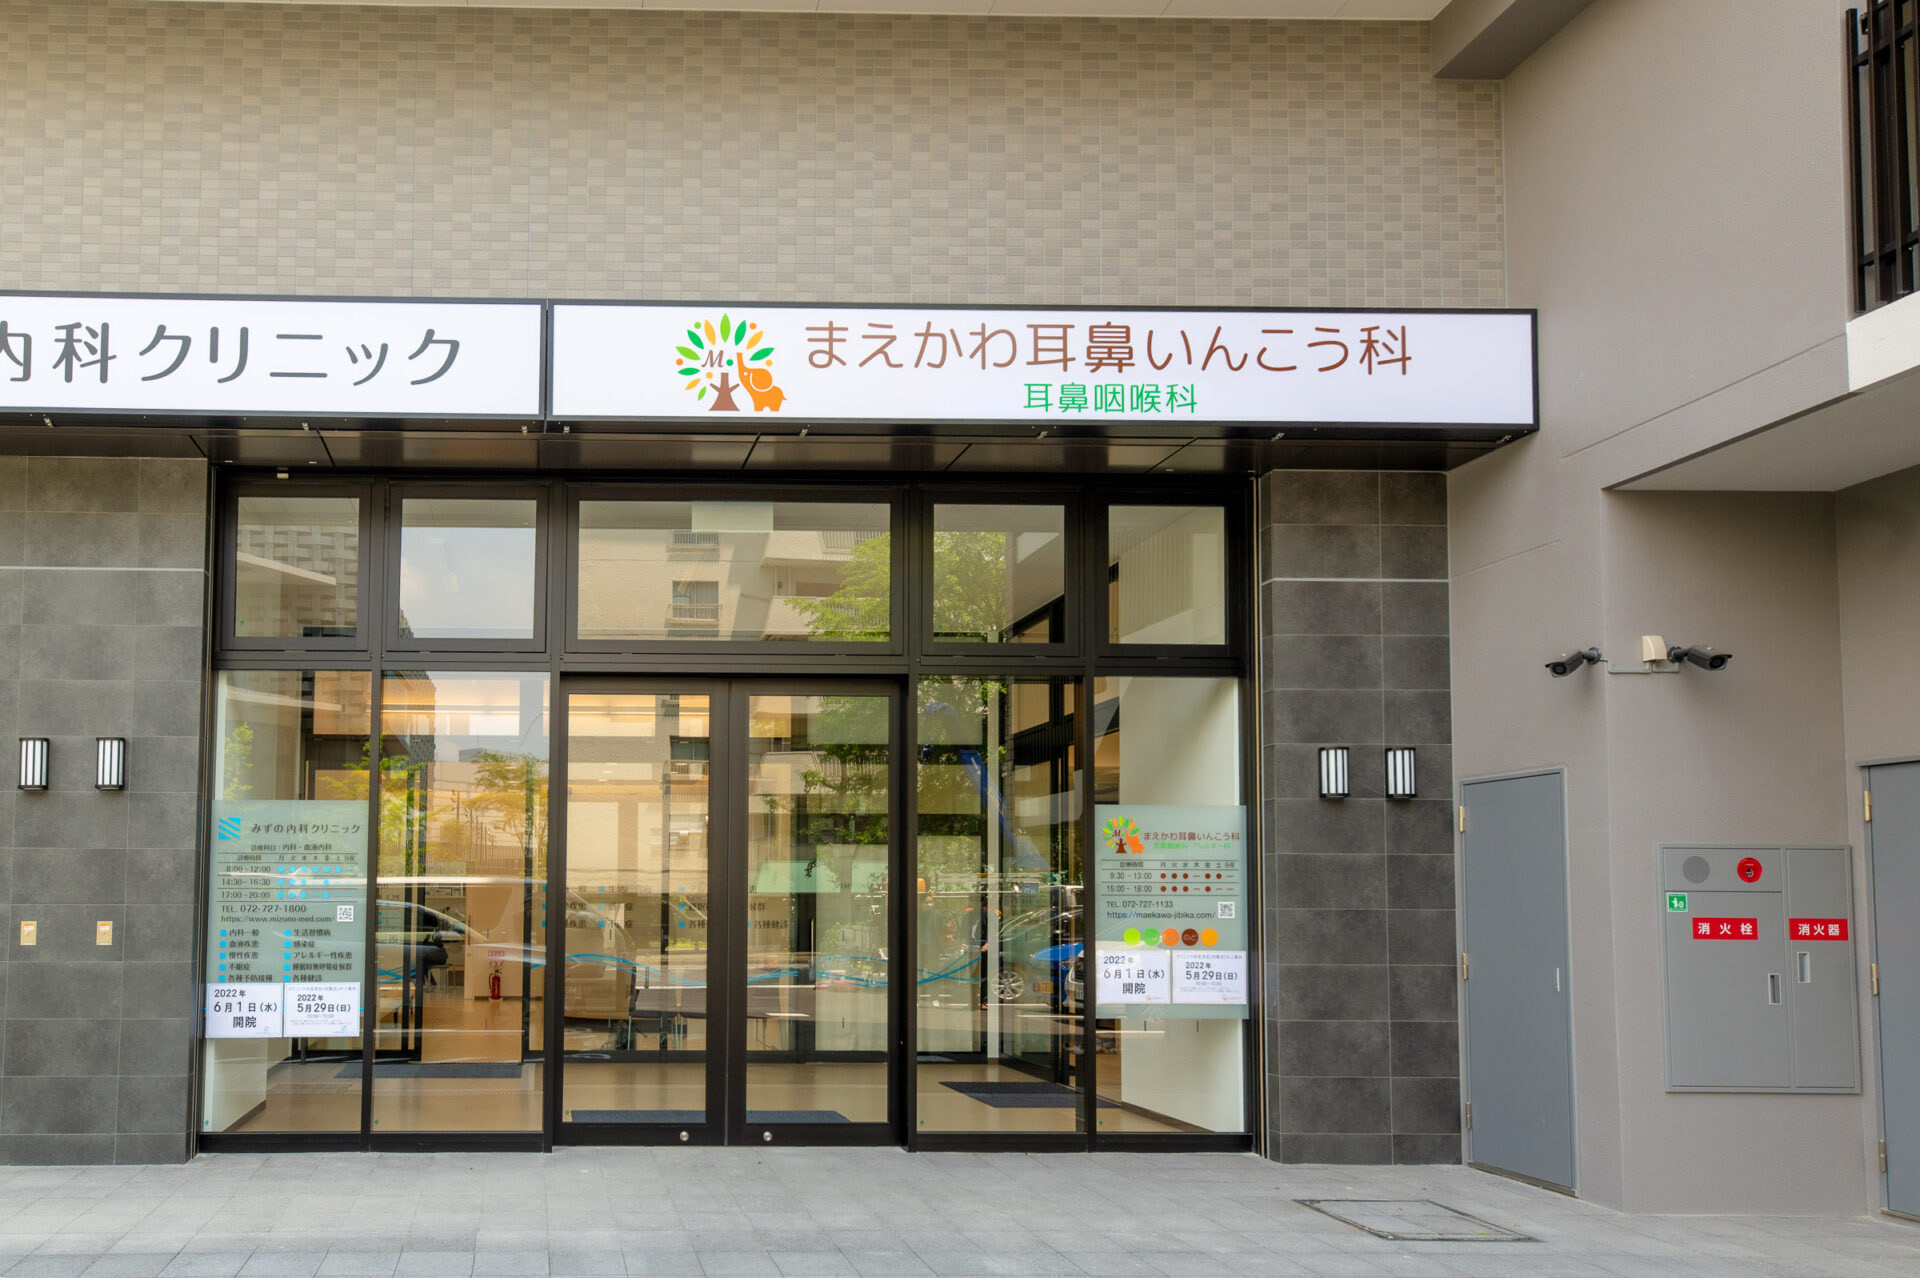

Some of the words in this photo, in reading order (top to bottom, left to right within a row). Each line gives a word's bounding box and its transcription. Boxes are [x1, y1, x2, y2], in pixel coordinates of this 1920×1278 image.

[805, 320, 1412, 376] まえかわ耳鼻いんこう科
[1023, 382, 1198, 413] 耳鼻咽喉科
[251, 824, 360, 834] みずの内科クリニック
[1144, 832, 1240, 841] まえかわ耳鼻いんこう科
[240, 905, 307, 913] 072-727-1800
[1698, 922, 1753, 935] 消火栓
[1798, 923, 1840, 936] 消火器
[1122, 982, 1146, 994] 開院
[233, 1016, 257, 1028] 開院
